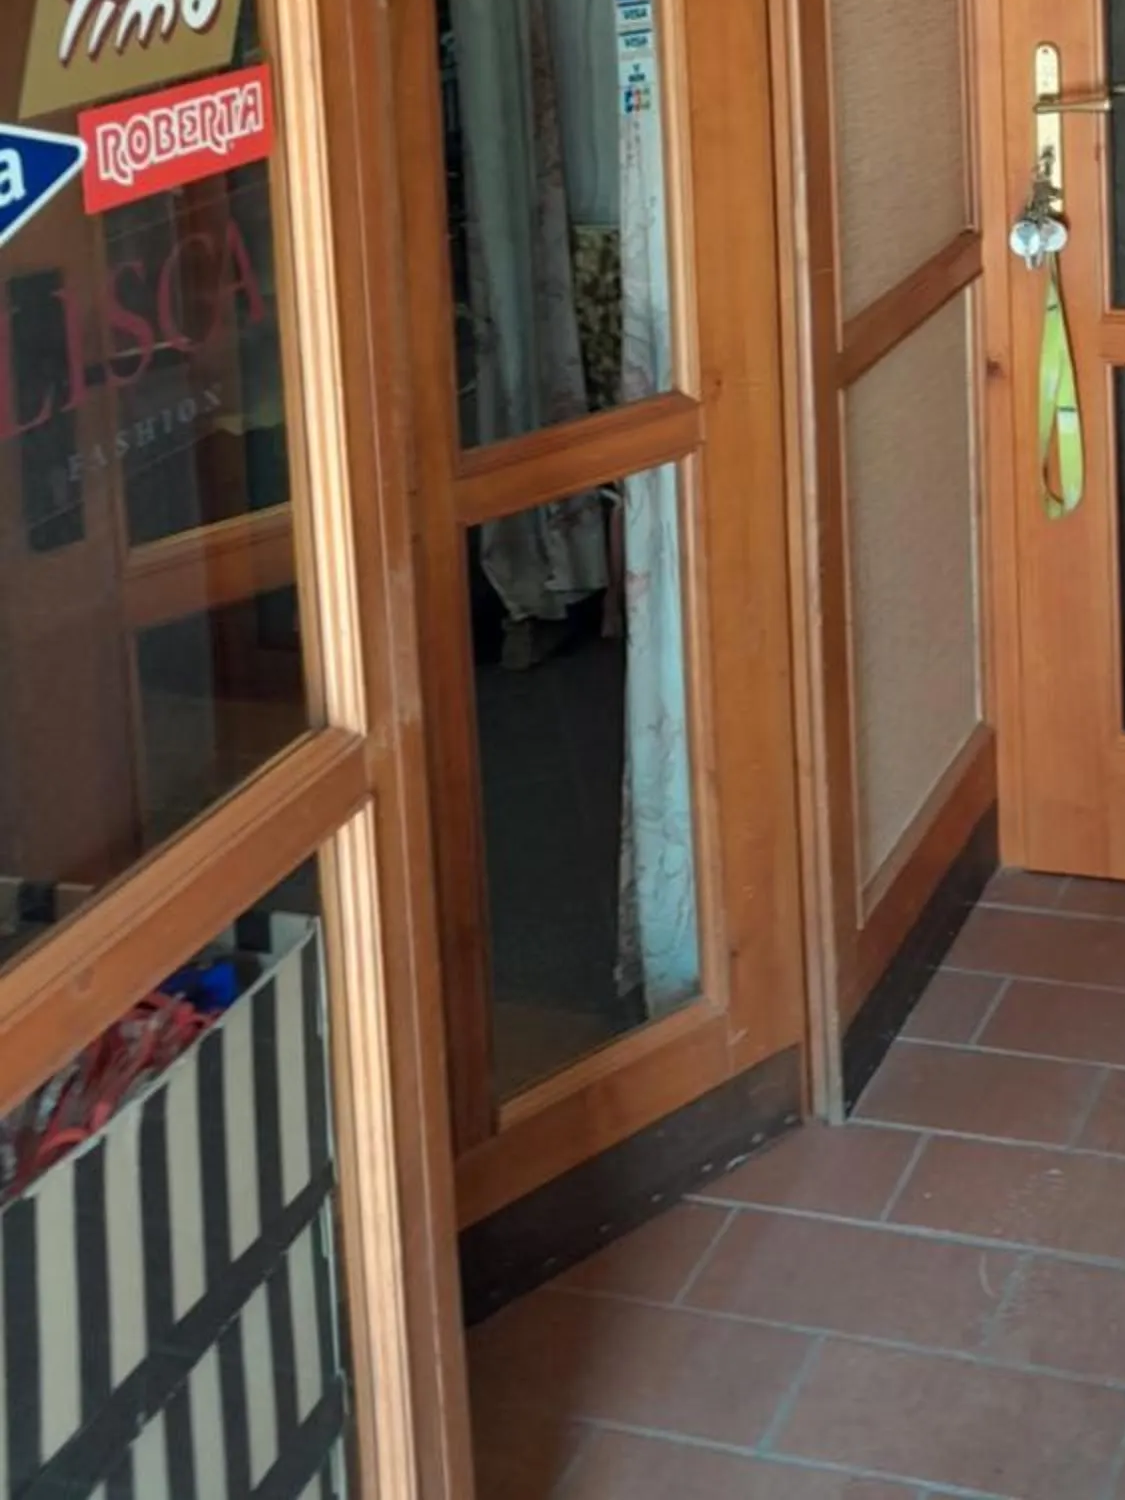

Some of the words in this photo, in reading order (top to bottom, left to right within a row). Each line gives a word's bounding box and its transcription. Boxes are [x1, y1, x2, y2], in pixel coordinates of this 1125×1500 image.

[95, 82, 265, 187] ROBERTA
[0, 215, 268, 445] LISCA
[64, 380, 224, 483] FASHION
